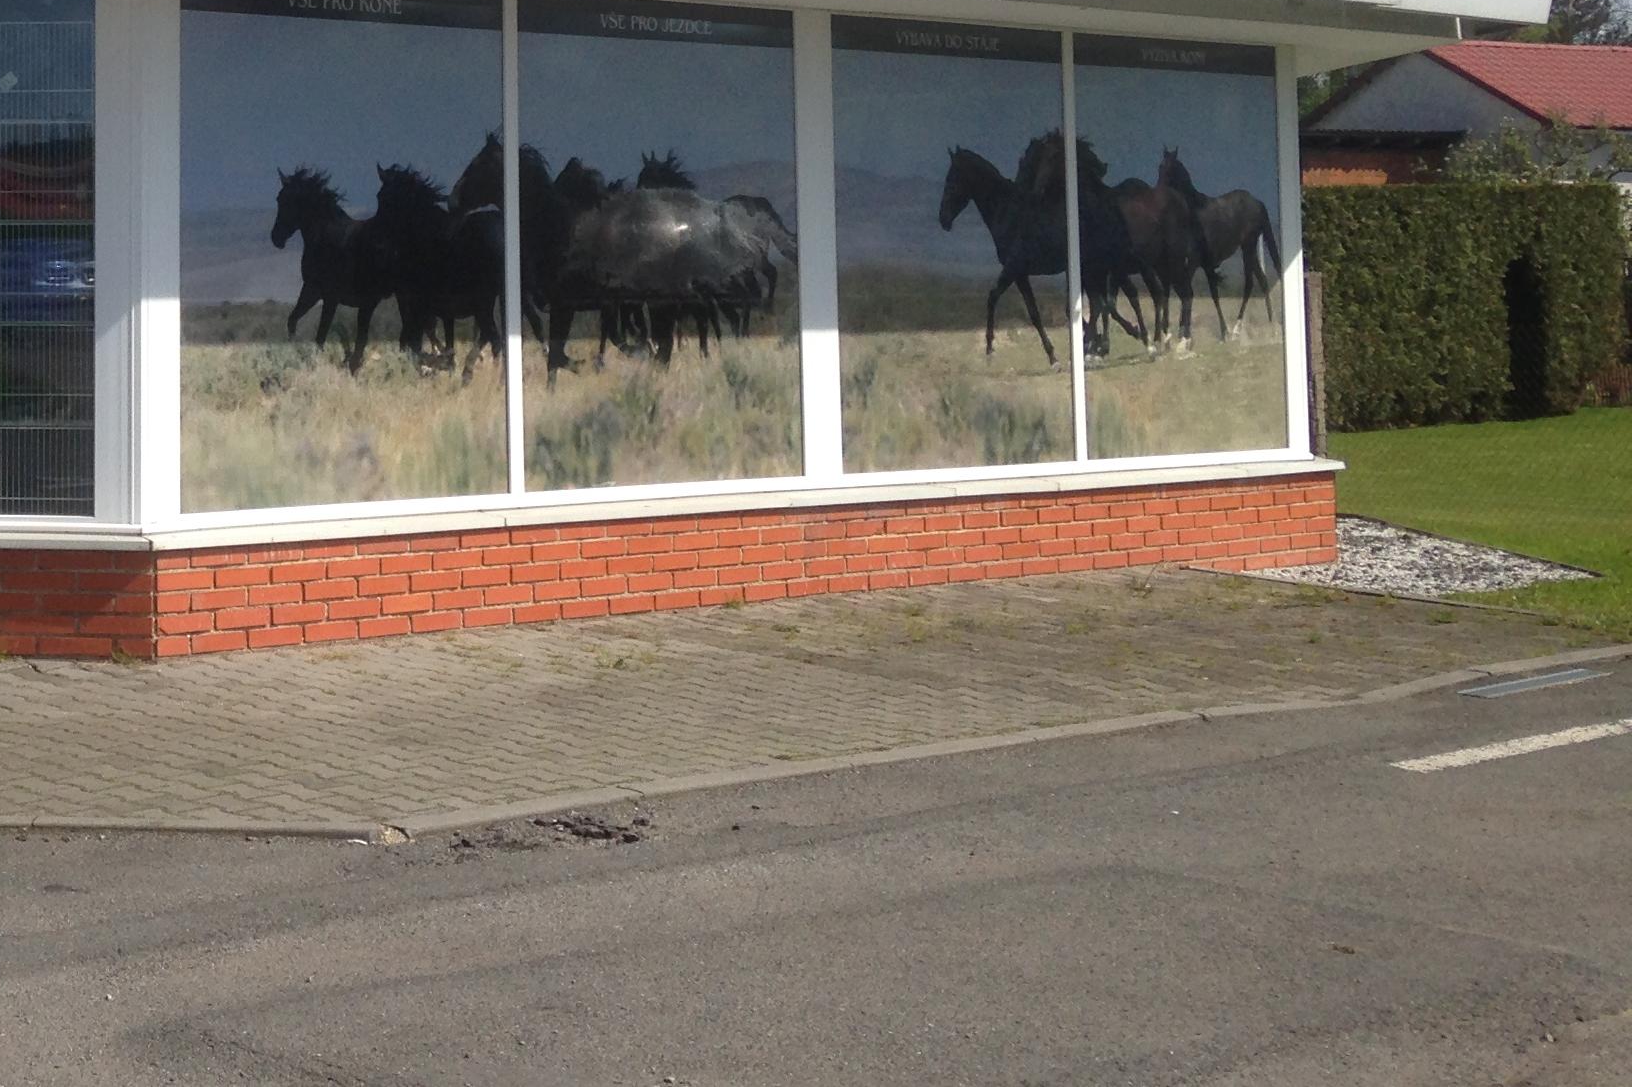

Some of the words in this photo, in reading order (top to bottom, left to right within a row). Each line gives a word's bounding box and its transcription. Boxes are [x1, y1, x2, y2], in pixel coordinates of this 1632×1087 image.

[599, 11, 626, 30] VŠE
[630, 15, 658, 32] PRO
[662, 17, 713, 35] JEZDCE
[944, 33, 962, 49] DO
